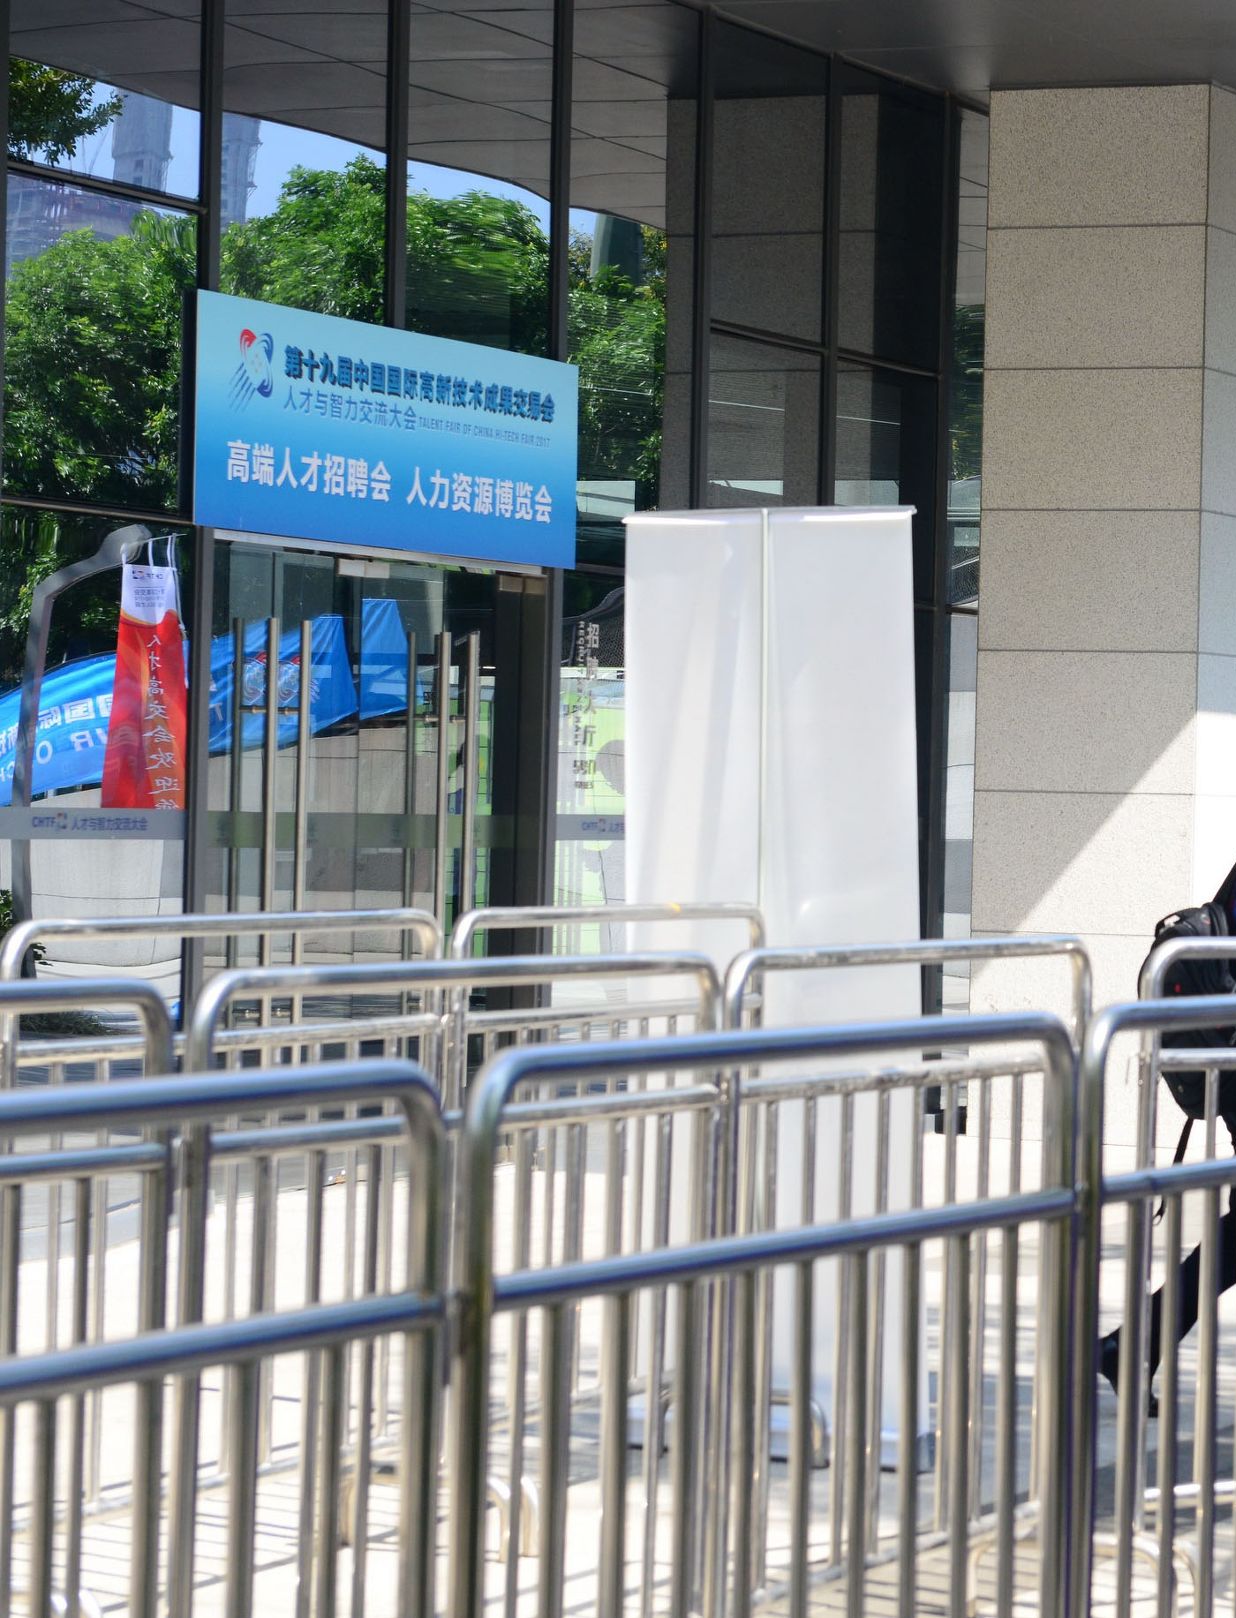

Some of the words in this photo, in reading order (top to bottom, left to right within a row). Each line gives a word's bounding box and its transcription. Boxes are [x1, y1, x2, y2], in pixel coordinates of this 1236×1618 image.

[284, 344, 555, 424] 第十九届中国国际高新技术成果交易会
[284, 385, 417, 432] 人才与智力交流大会
[419, 416, 443, 431] TALENT
[446, 420, 461, 433] FAIR
[463, 424, 472, 435] OF
[474, 425, 494, 439] CHINA
[495, 429, 520, 443] HI-TECH
[521, 433, 535, 446] FAIR
[536, 436, 550, 448] 2017
[227, 440, 391, 503] 高端人才招聘会
[407, 466, 553, 524] 人力资源博览会
